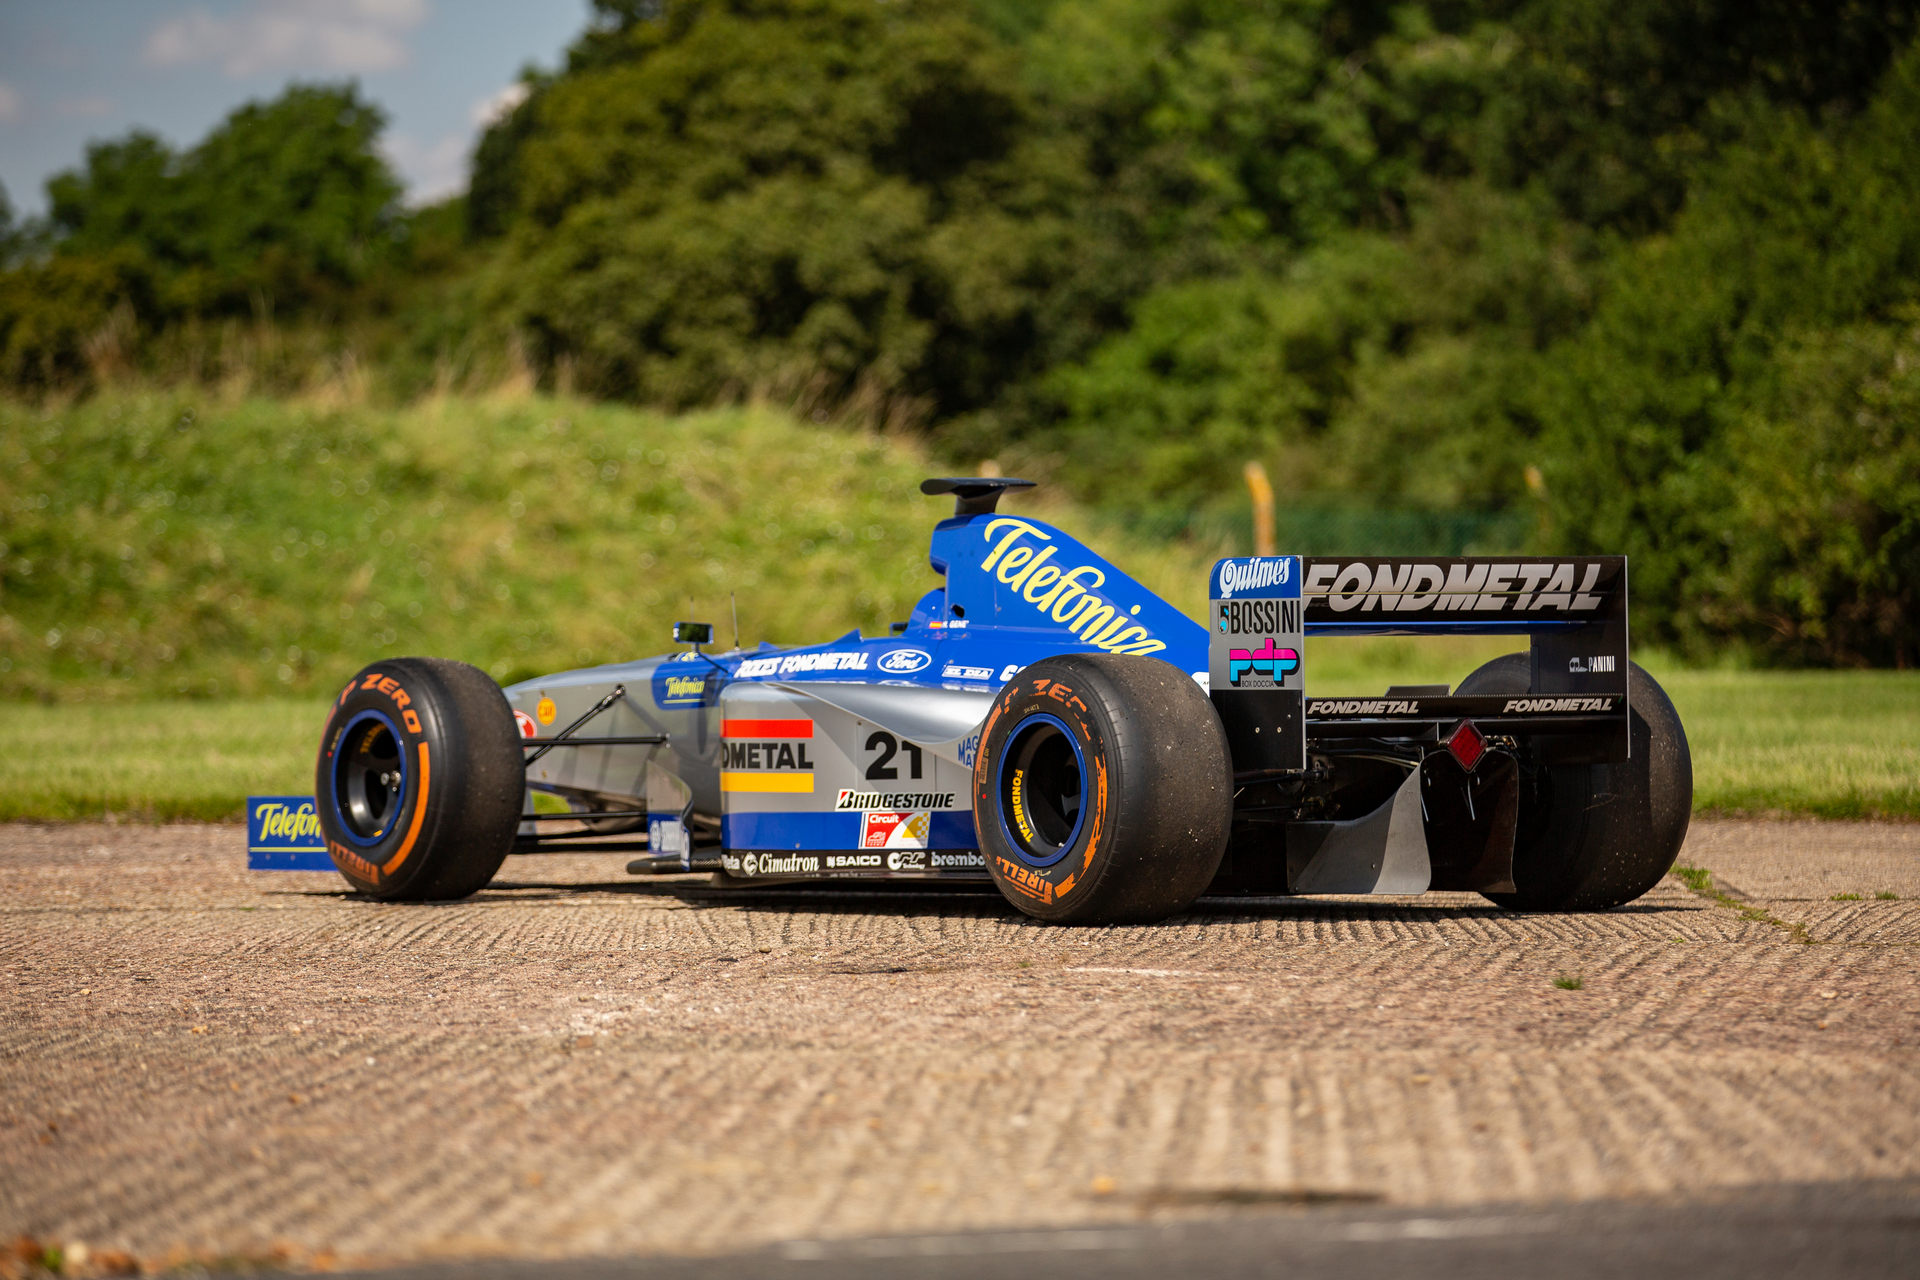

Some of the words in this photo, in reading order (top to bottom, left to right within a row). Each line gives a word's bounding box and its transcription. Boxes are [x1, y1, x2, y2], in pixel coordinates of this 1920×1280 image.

[1219, 557, 1291, 599] Quilmes
[1302, 562, 1603, 612] FONDMETAL
[1231, 600, 1301, 634] BOSSINI
[778, 652, 869, 674] FONDMETAL
[887, 652, 922, 670] Ford
[1230, 637, 1300, 688] pdp
[1588, 655, 1615, 673] PANINI
[360, 673, 422, 734] ZERO
[1307, 700, 1420, 715] FONDMETAL
[1503, 697, 1613, 713] FONDMETAL
[864, 730, 923, 781] 21
[838, 788, 955, 809] BRIDGESTONE
[1011, 768, 1034, 843] FONDMETAL
[869, 814, 899, 824] Circuit
[759, 853, 819, 873] Cimatron
[836, 855, 882, 867] SAICO
[931, 852, 985, 867] brembo
